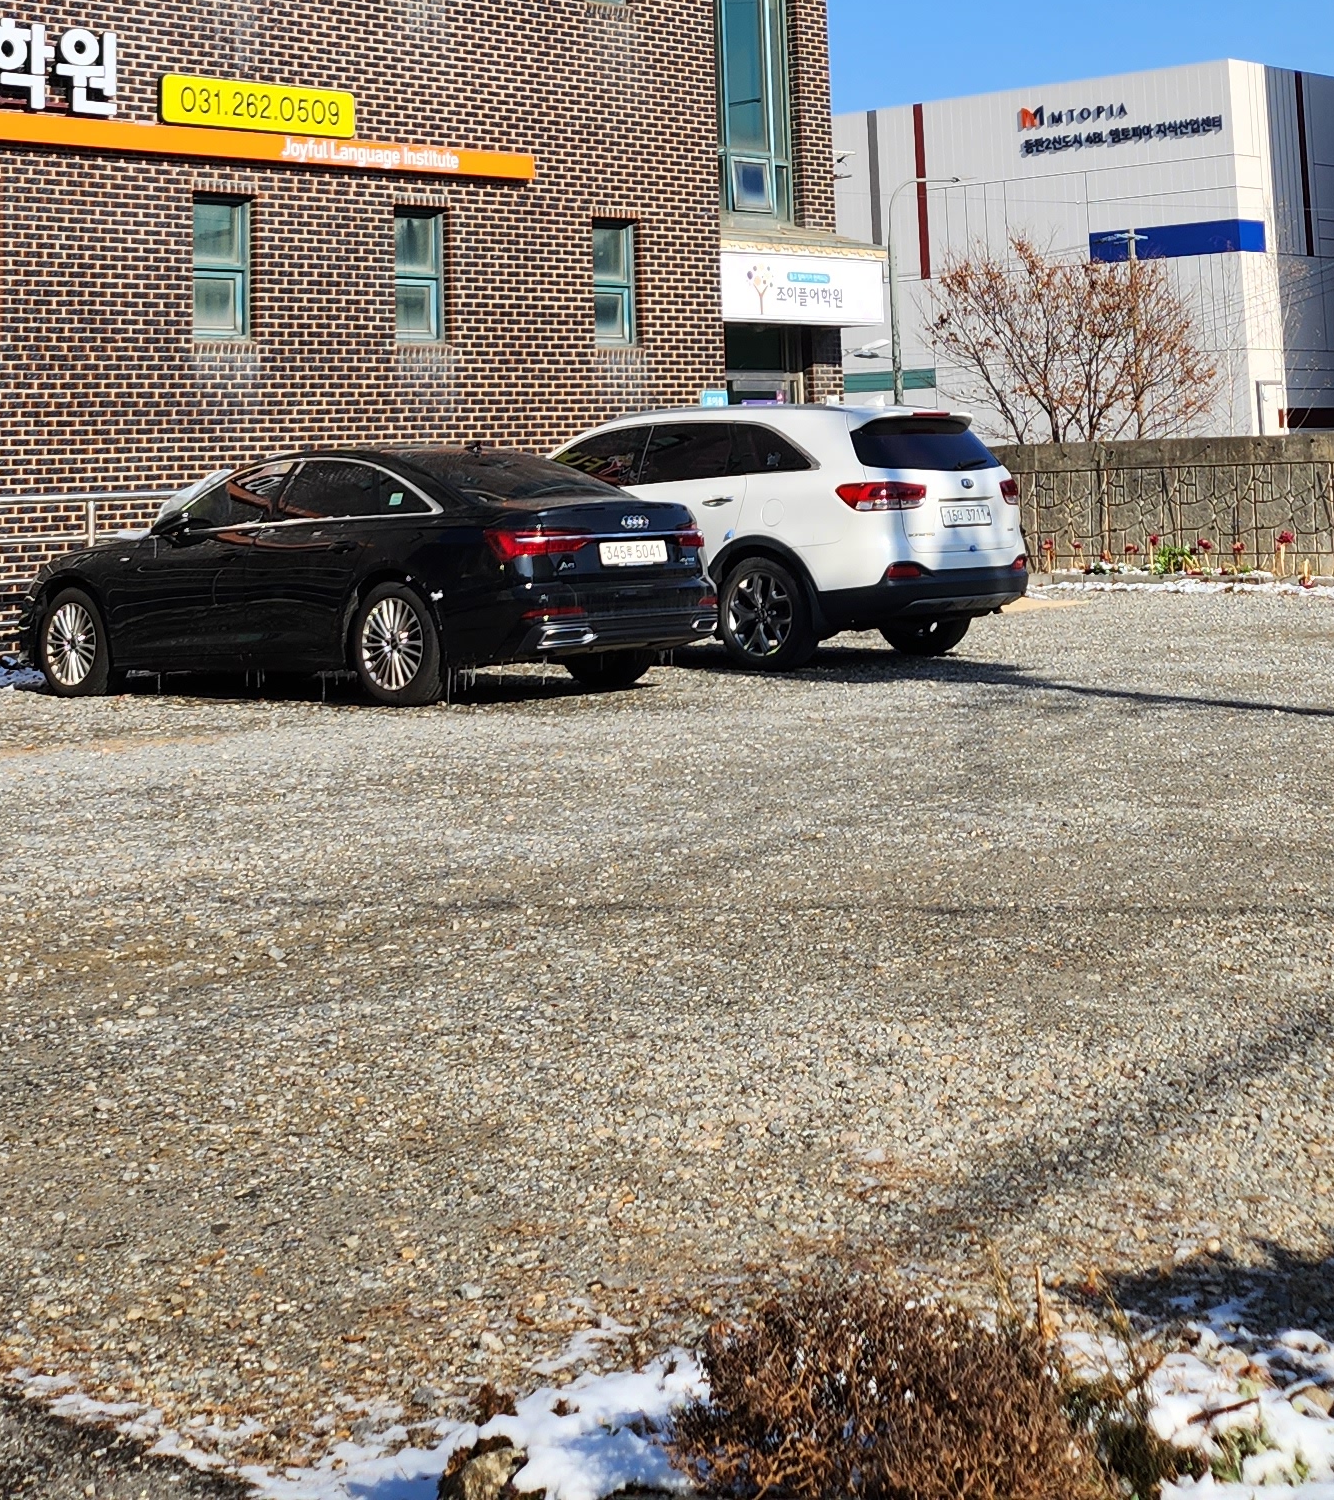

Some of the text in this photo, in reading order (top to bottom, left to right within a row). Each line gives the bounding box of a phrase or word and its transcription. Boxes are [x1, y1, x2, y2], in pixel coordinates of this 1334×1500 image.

[180, 85, 340, 126] 031.262.0509
[1050, 102, 1128, 125] MTOPIA
[1155, 114, 1223, 137] 지식산업센터
[281, 136, 460, 170] Joyful Language Institute
[966, 508, 986, 521] 3711
[635, 543, 662, 559] 5041
